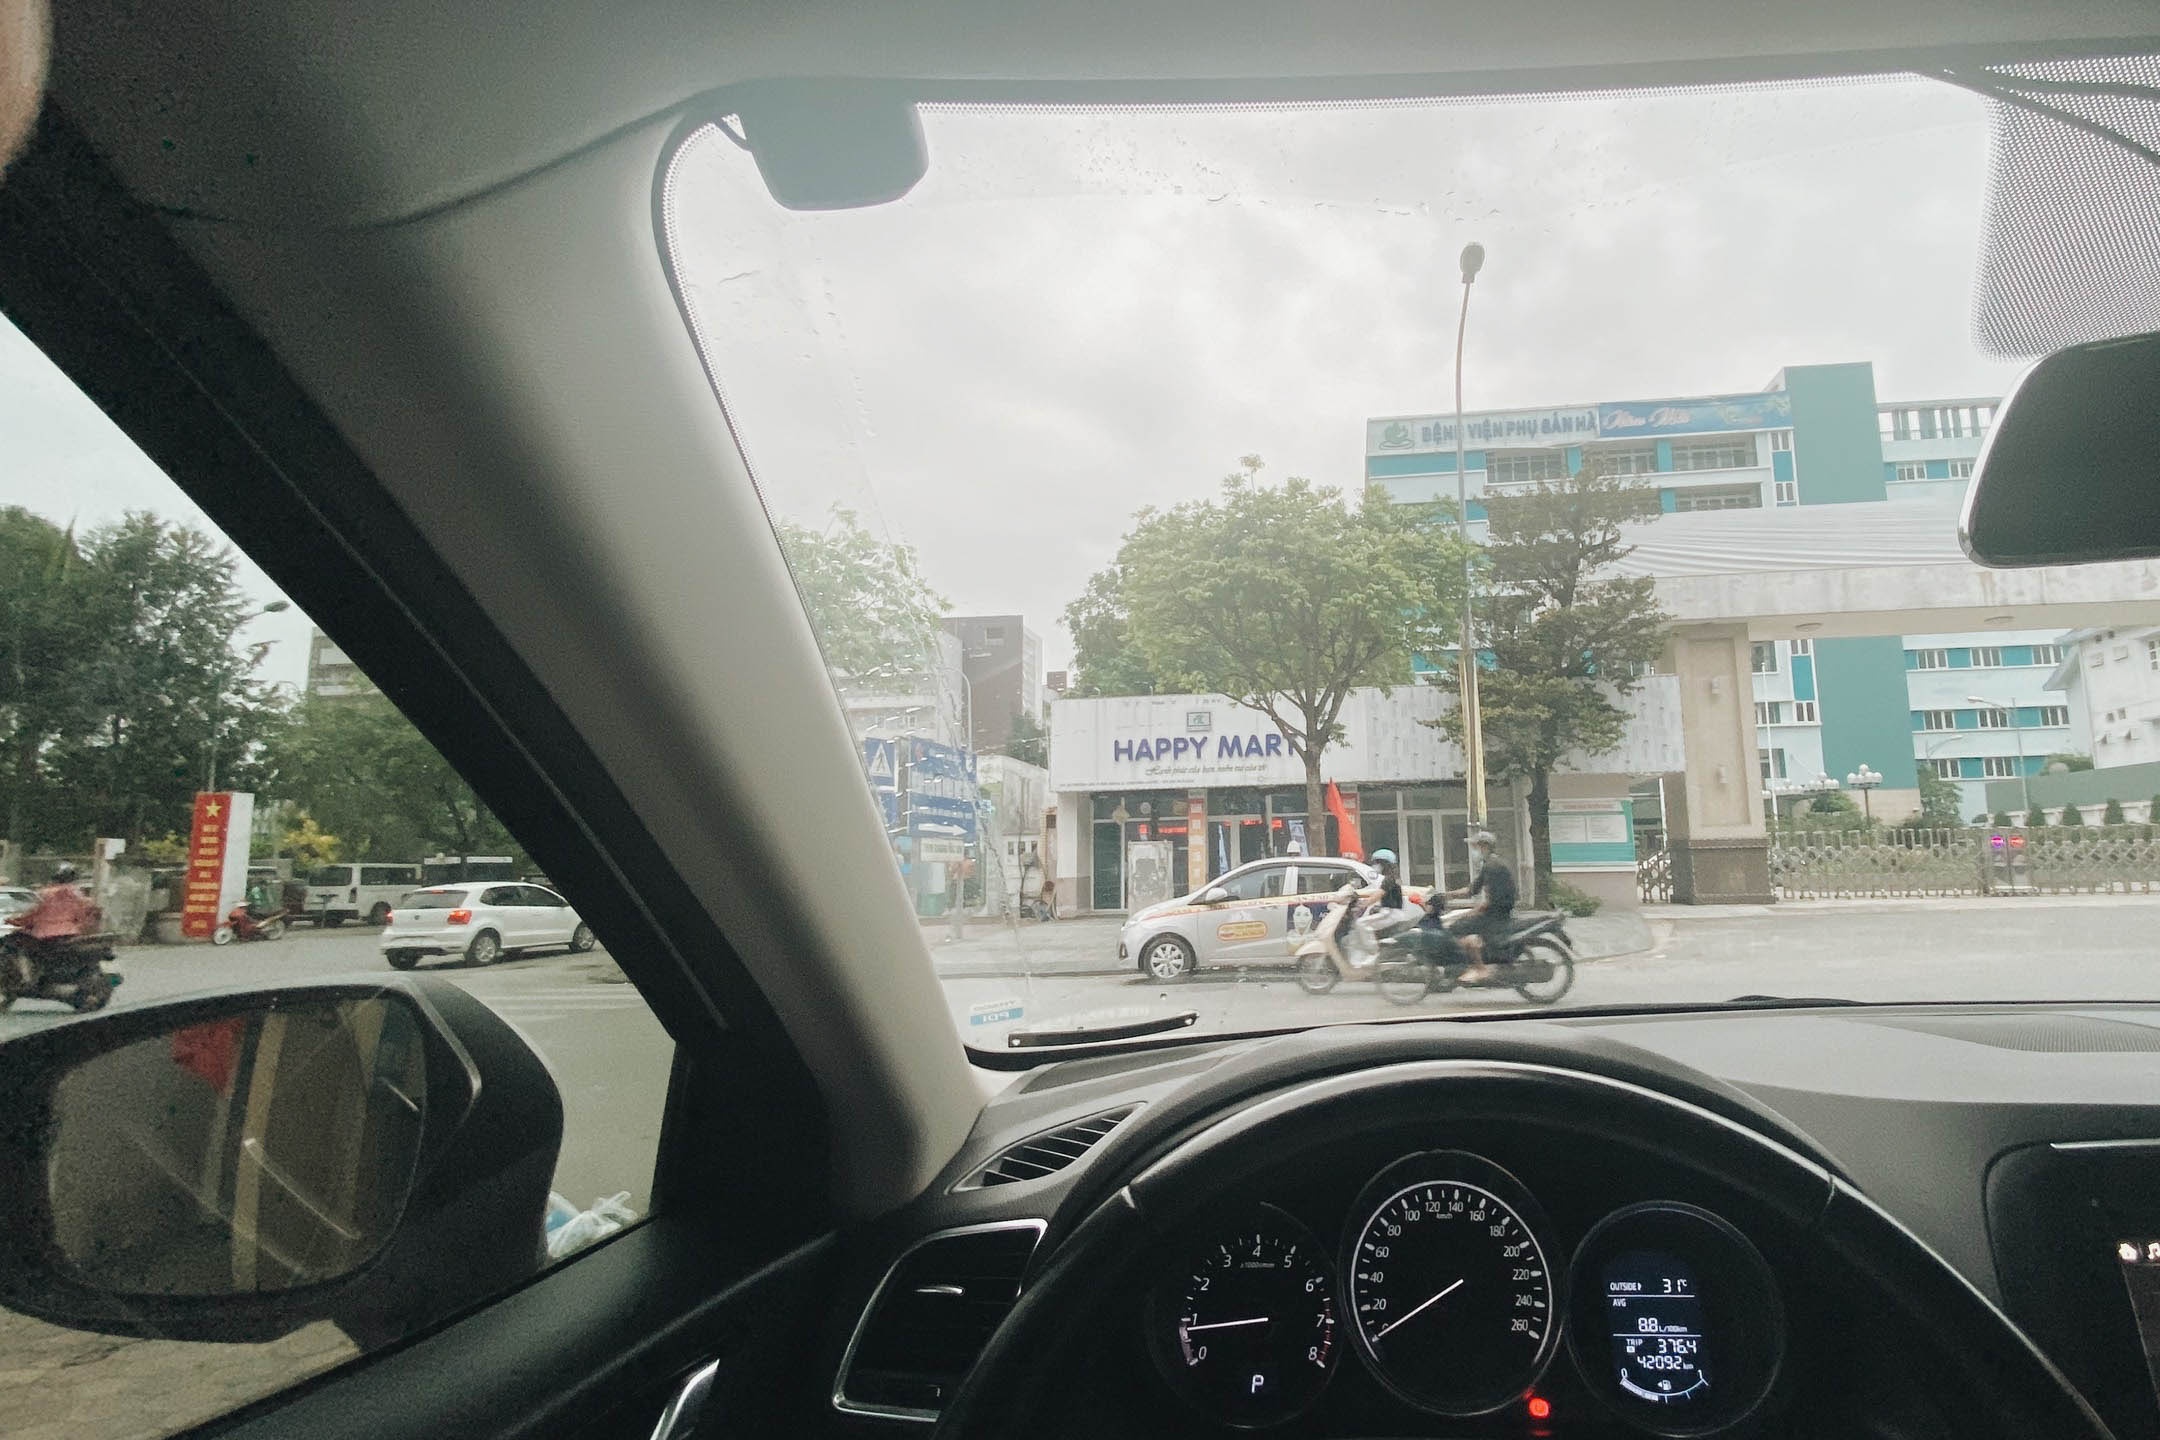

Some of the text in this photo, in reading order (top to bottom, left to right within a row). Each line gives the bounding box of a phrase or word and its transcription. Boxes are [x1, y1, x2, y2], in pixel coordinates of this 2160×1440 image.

[1114, 736, 1208, 762] HAPPY
[1425, 1201, 1441, 1213] 120
[1449, 1201, 1464, 1213] 140
[1405, 1210, 1421, 1221] 100
[1470, 1210, 1486, 1221] 160
[1387, 1225, 1402, 1236] 80
[1490, 1225, 1505, 1237] 180
[1252, 1245, 1261, 1257] 4
[1375, 1247, 1389, 1258] 60
[1503, 1246, 1520, 1257] 200
[1223, 1254, 1232, 1268] 3
[1283, 1255, 1292, 1268] 5
[1369, 1271, 1384, 1283] 40
[1512, 1268, 1529, 1280] 220
[1200, 1277, 1210, 1291] 2
[1305, 1279, 1314, 1292] 6
[1610, 1282, 1637, 1291] OUTSIDE
[1372, 1298, 1387, 1310] 20
[1515, 1294, 1532, 1307] 240
[1612, 1298, 1626, 1307] AVG
[1192, 1313, 1198, 1326] 1
[1316, 1314, 1325, 1327] 7
[1511, 1319, 1528, 1331] 260
[1626, 1338, 1643, 1346] TRIP
[1198, 1346, 1207, 1360] 0
[1308, 1346, 1317, 1361] 8
[1637, 1355, 1682, 1370] 42092
[1251, 1374, 1264, 1393] P
